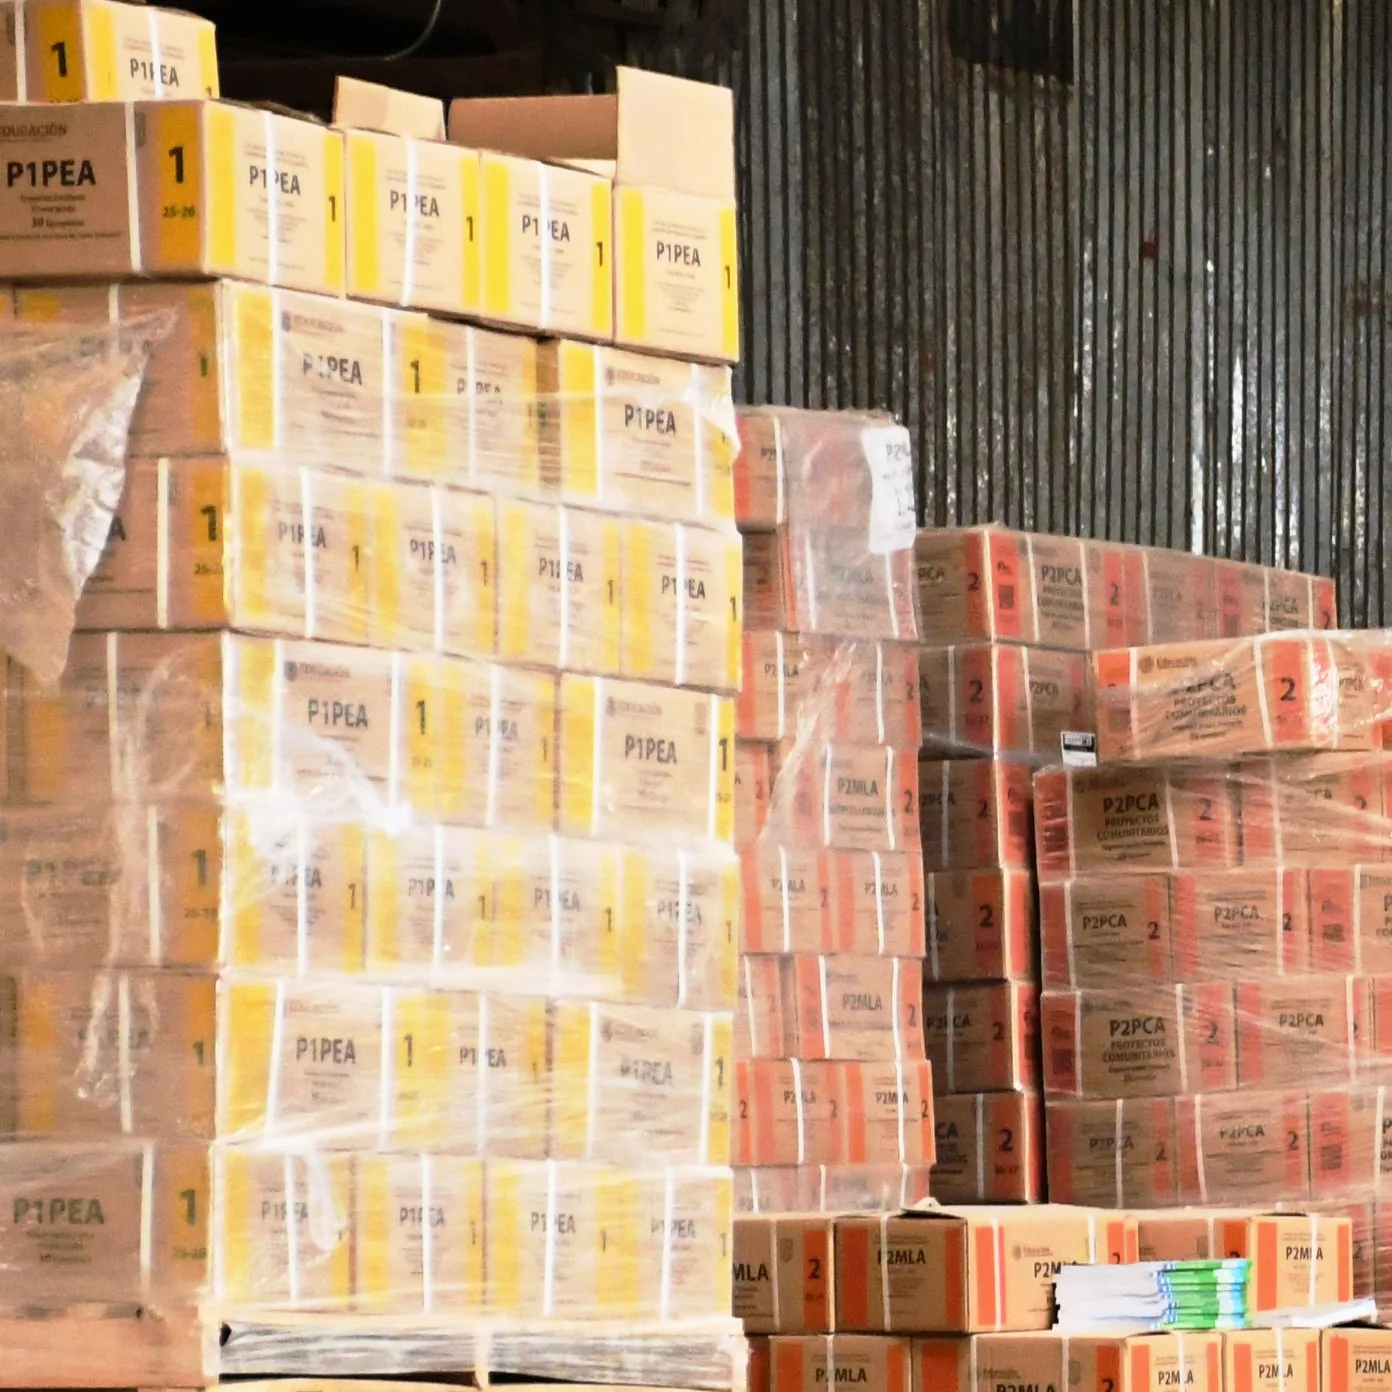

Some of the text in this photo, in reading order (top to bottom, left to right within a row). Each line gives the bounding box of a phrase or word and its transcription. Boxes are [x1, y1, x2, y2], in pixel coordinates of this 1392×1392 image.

[51, 41, 67, 77] 1
[6, 160, 95, 188] P1PEA
[168, 146, 184, 184] 1
[596, 241, 603, 266] 1
[656, 241, 700, 267] P1PEA
[410, 360, 419, 393] 1
[625, 404, 676, 434] P1PEA
[201, 505, 217, 541] 1
[1041, 565, 1081, 585] P2PCA
[1280, 678, 1296, 701] 2
[308, 699, 368, 729] P1PEA
[625, 734, 677, 764] P1PEA
[837, 778, 878, 797] P2MLA
[1103, 792, 1159, 813] P2PCA
[1083, 914, 1127, 930] P2PCA
[1110, 1017, 1165, 1036] P2PCA
[1280, 1013, 1324, 1028] P2PCA
[297, 1037, 355, 1065] P1PEA
[13, 1198, 104, 1225] P1PEA
[809, 1259, 820, 1279] 2
[1355, 1359, 1391, 1374] P2MLA
